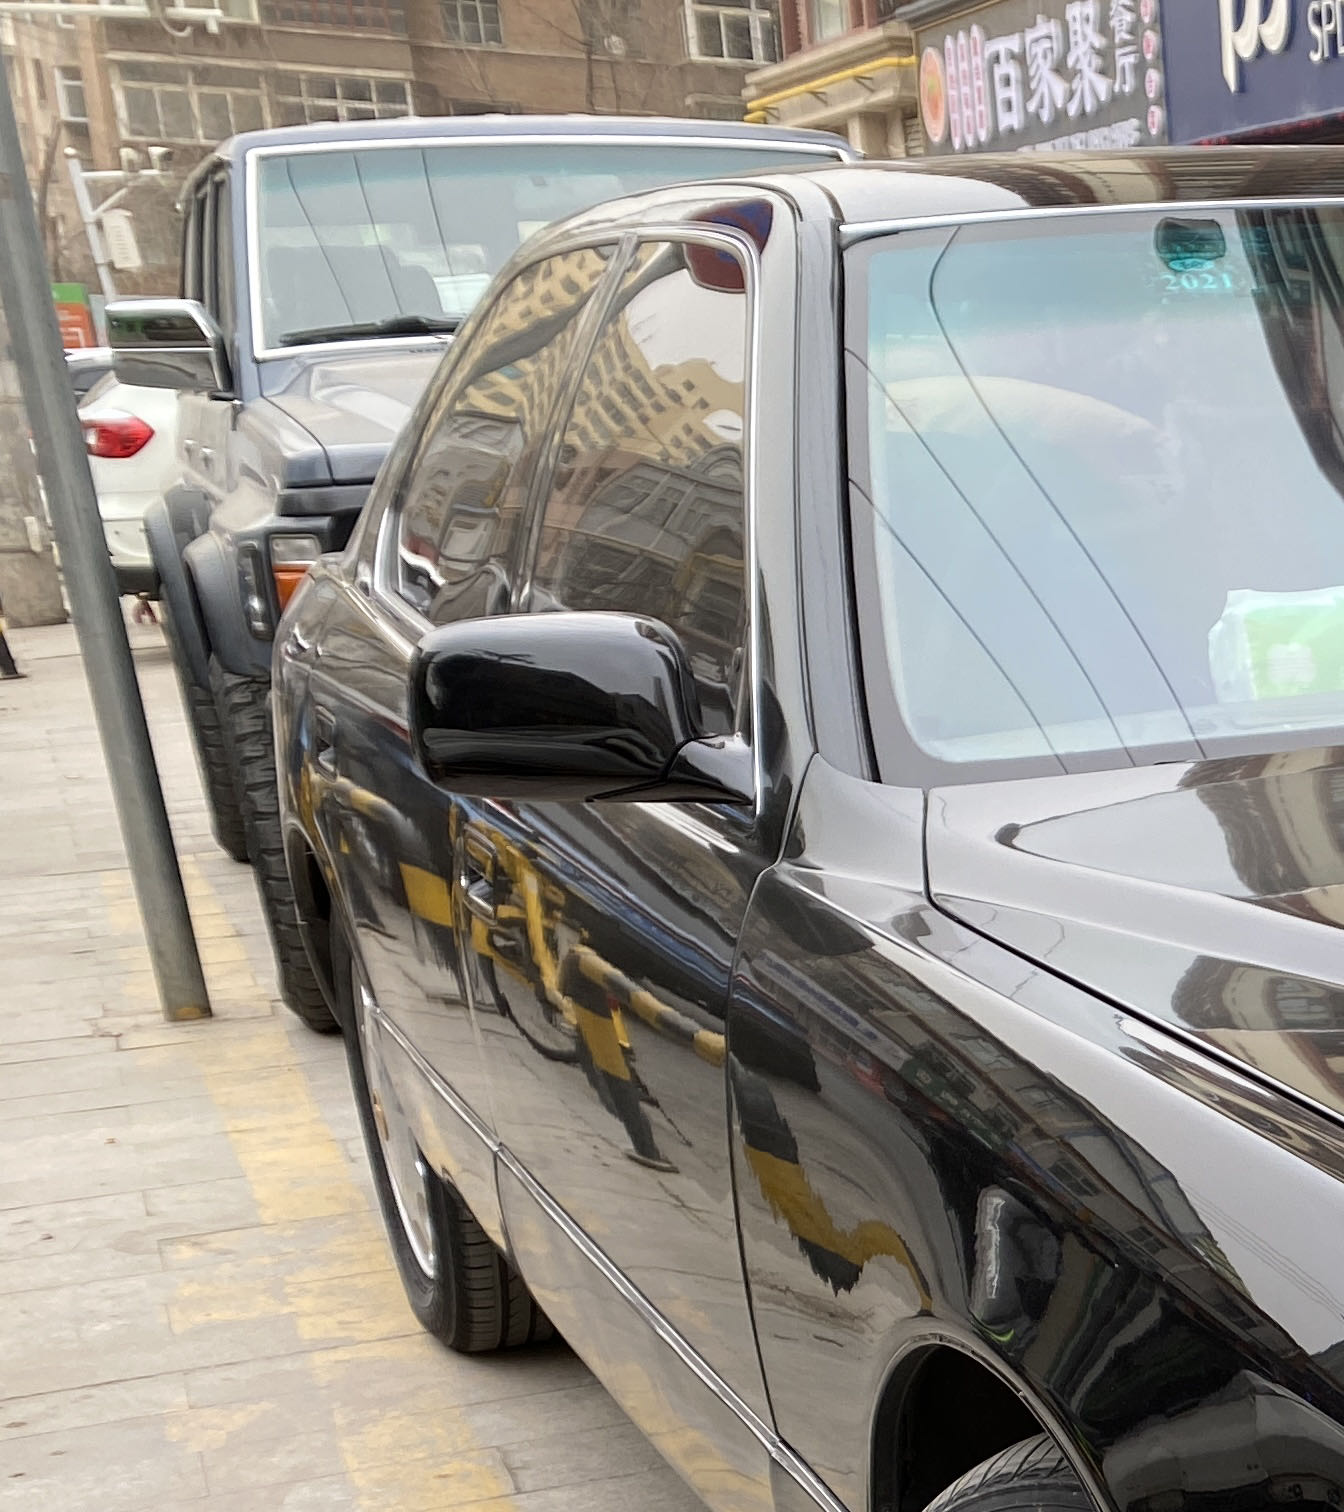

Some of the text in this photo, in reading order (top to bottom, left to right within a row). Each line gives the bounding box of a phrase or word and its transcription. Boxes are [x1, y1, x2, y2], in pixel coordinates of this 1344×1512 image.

[984, 0, 1113, 134] 百家聚
[1160, 272, 1232, 290] 2021
